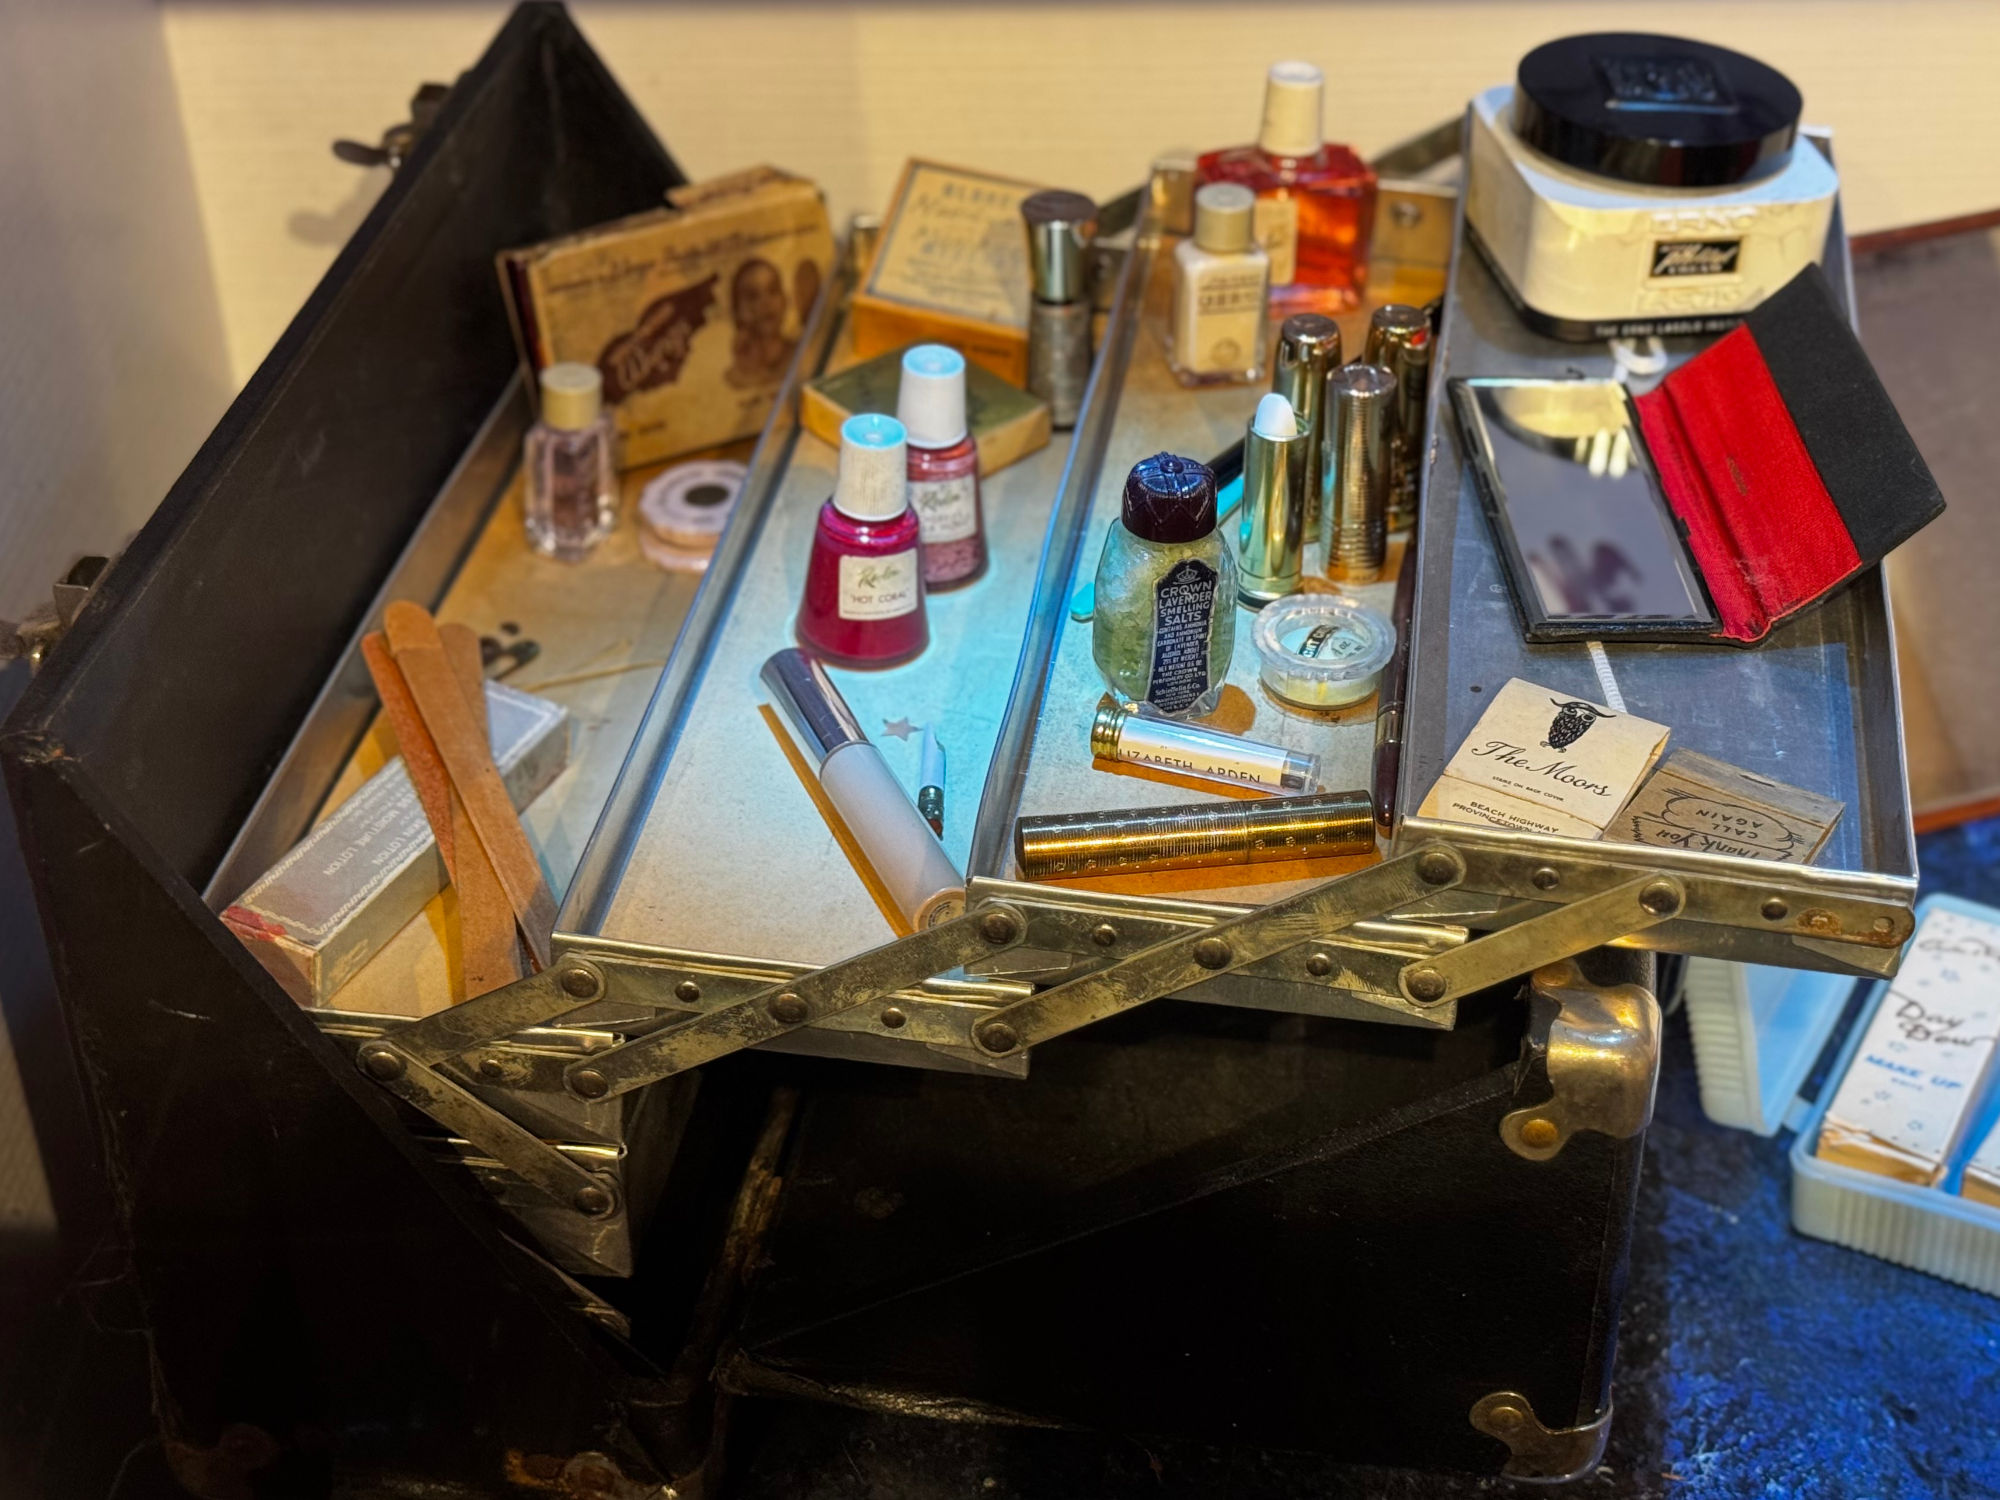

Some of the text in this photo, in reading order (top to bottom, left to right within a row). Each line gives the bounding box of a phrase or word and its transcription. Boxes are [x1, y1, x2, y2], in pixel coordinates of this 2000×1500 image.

[1160, 580, 1212, 598] CROWN
[1159, 590, 1212, 609] LAVENDER
[1160, 601, 1210, 618] SMELLING
[1164, 611, 1202, 626] SALTS
[1119, 748, 1261, 783] LIZABETH ARDEN
[1470, 741, 1612, 797] The Moors
[1470, 801, 1559, 833] BEACH HIGHWAY
[1695, 810, 1764, 828] AGAIN
[1656, 828, 1698, 848] You
[1711, 823, 1758, 839] CALL
[371, 836, 404, 865] LOTION
[322, 846, 359, 876] LOTION
